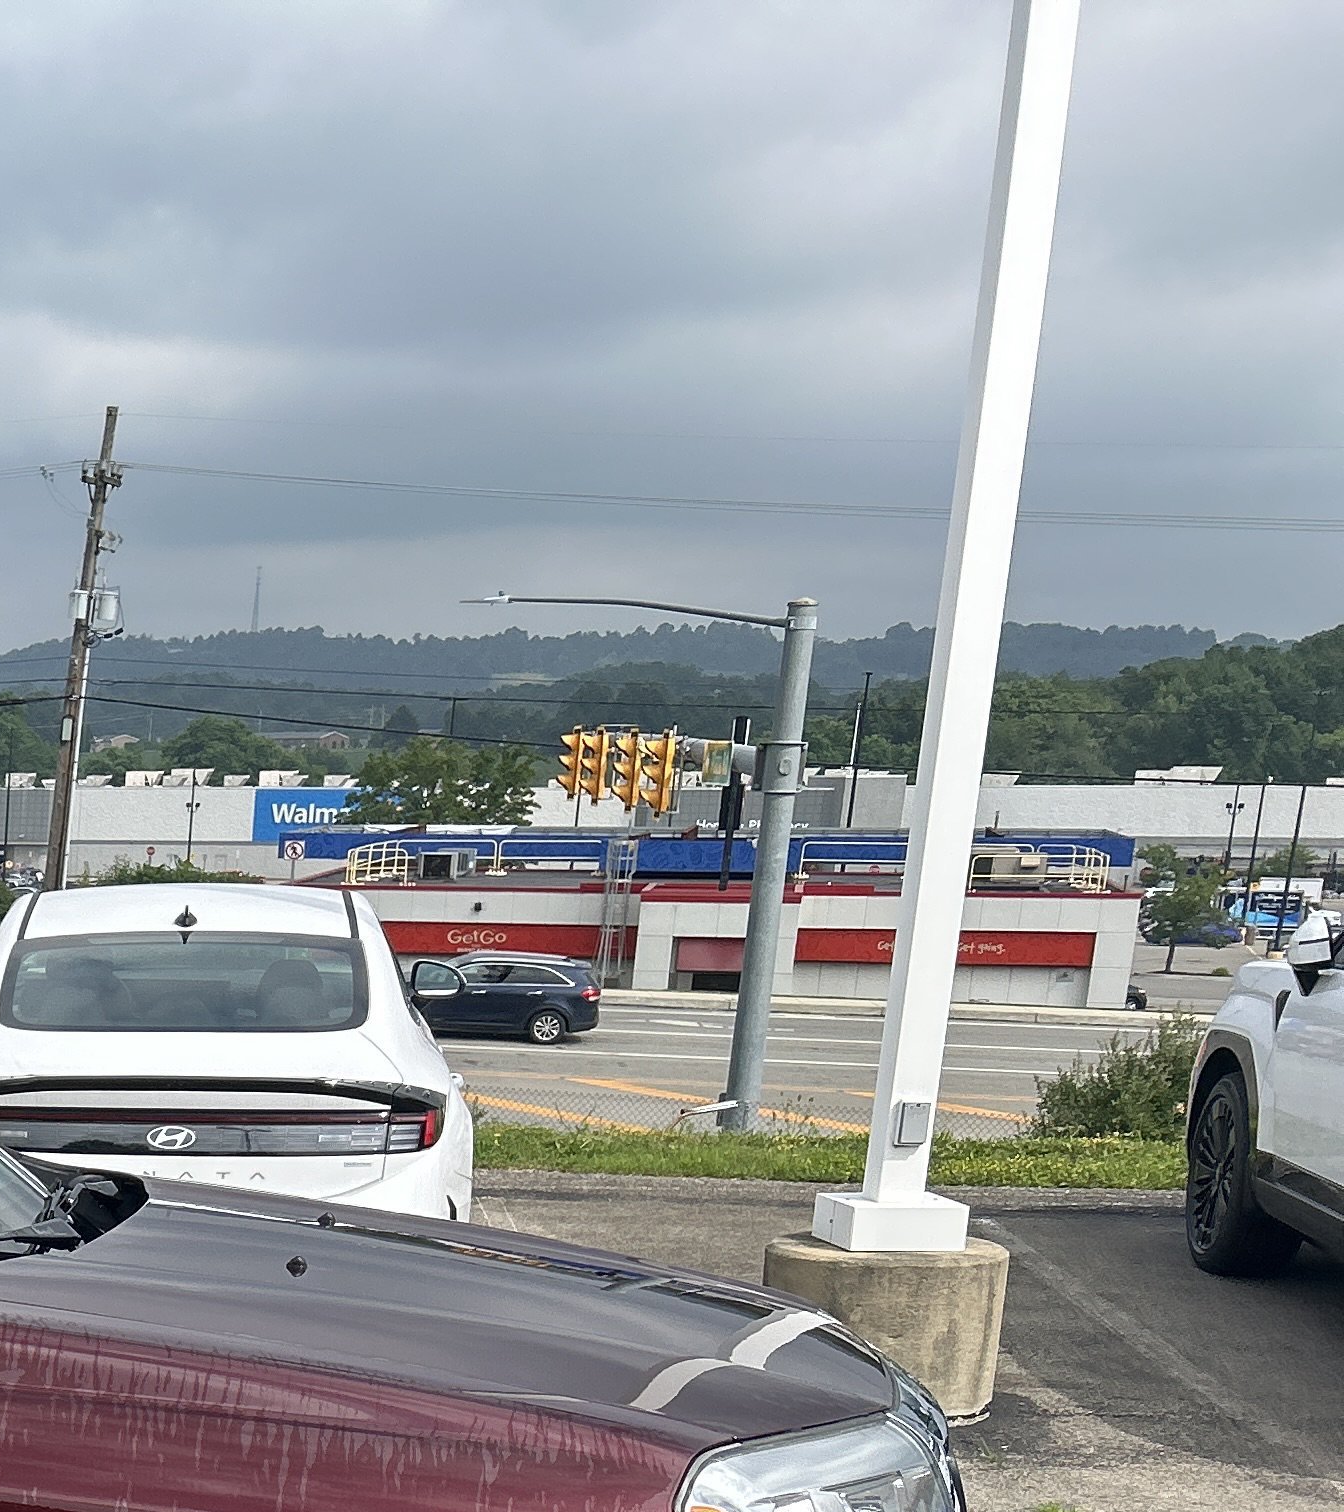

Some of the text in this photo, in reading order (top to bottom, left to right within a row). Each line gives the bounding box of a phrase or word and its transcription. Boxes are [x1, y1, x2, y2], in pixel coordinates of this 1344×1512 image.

[271, 803, 348, 824] Walm
[447, 929, 507, 944] GetGo
[143, 1171, 264, 1180] NATA
